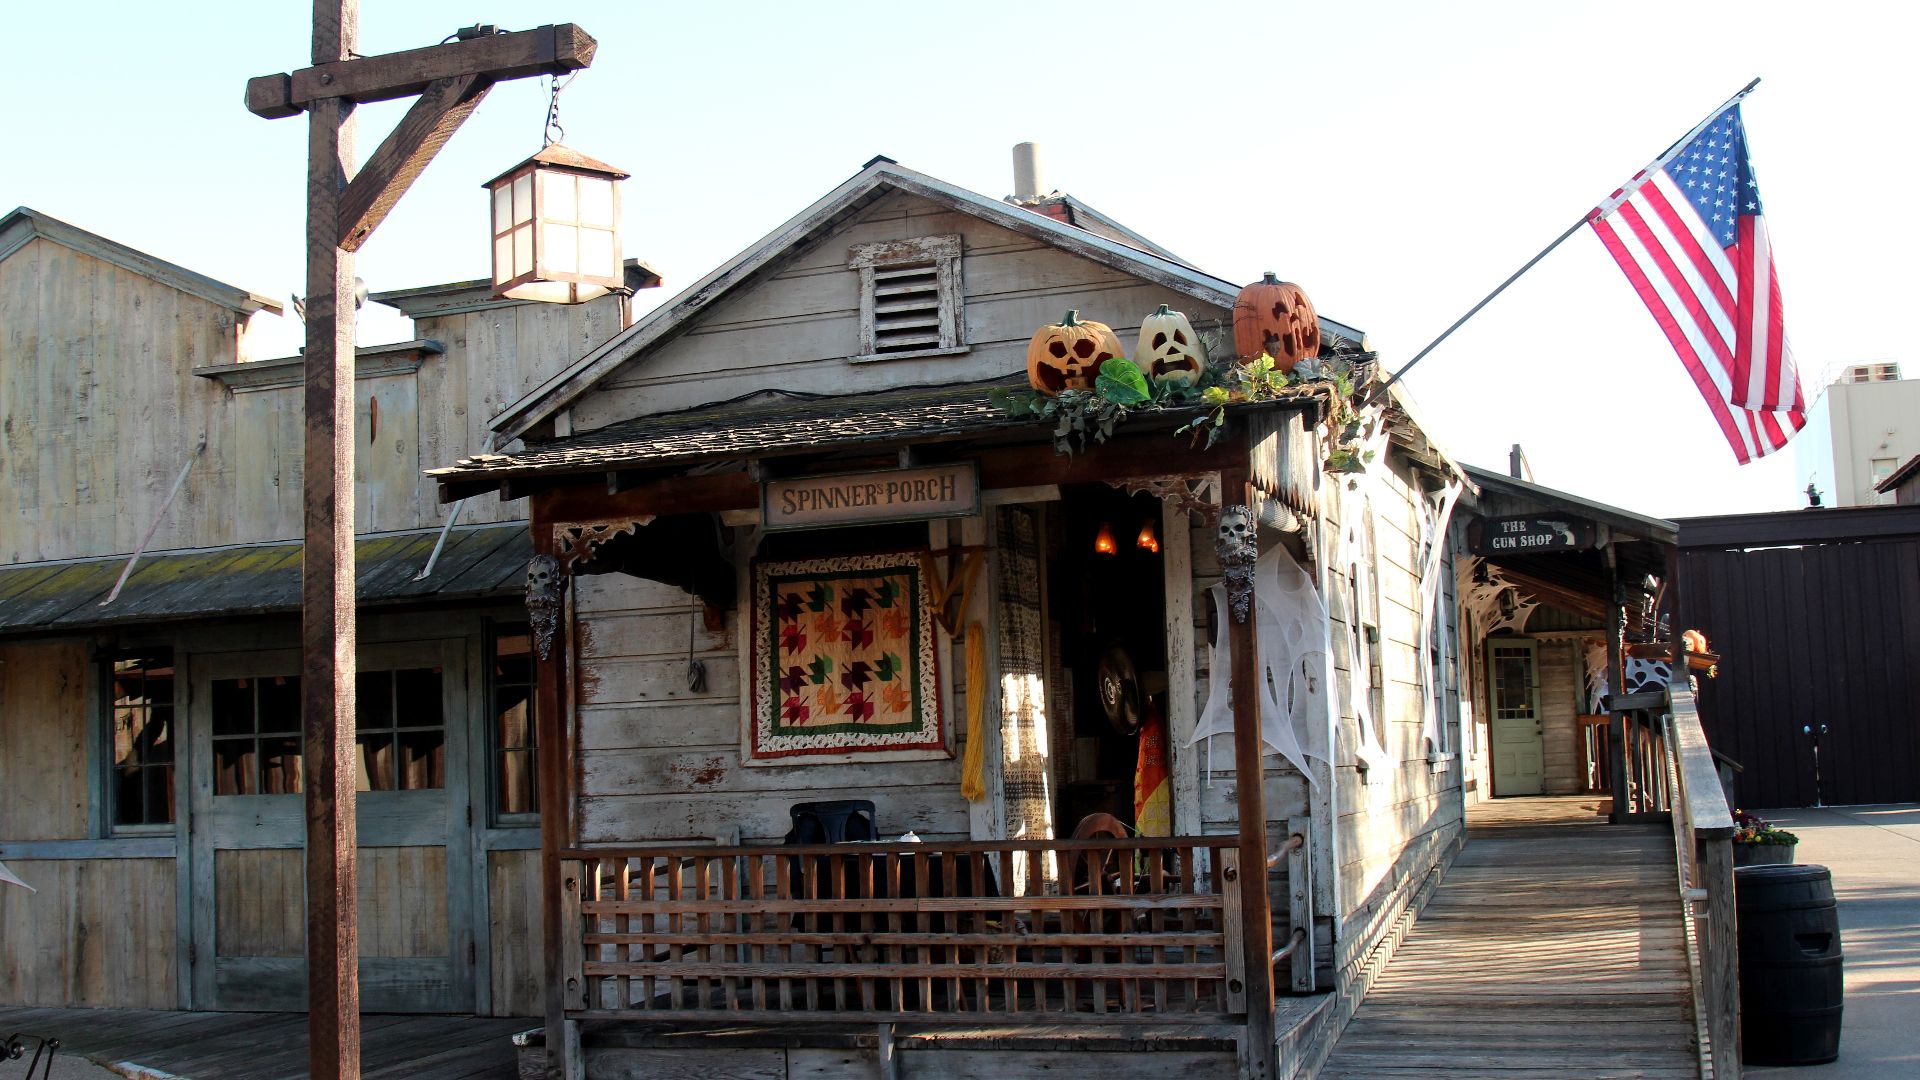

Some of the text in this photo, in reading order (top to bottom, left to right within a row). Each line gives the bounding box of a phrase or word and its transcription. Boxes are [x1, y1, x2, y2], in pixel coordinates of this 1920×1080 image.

[886, 474, 956, 505] PORCH
[1501, 521, 1527, 533] THE
[1492, 534, 1553, 549] GUN SHOP
